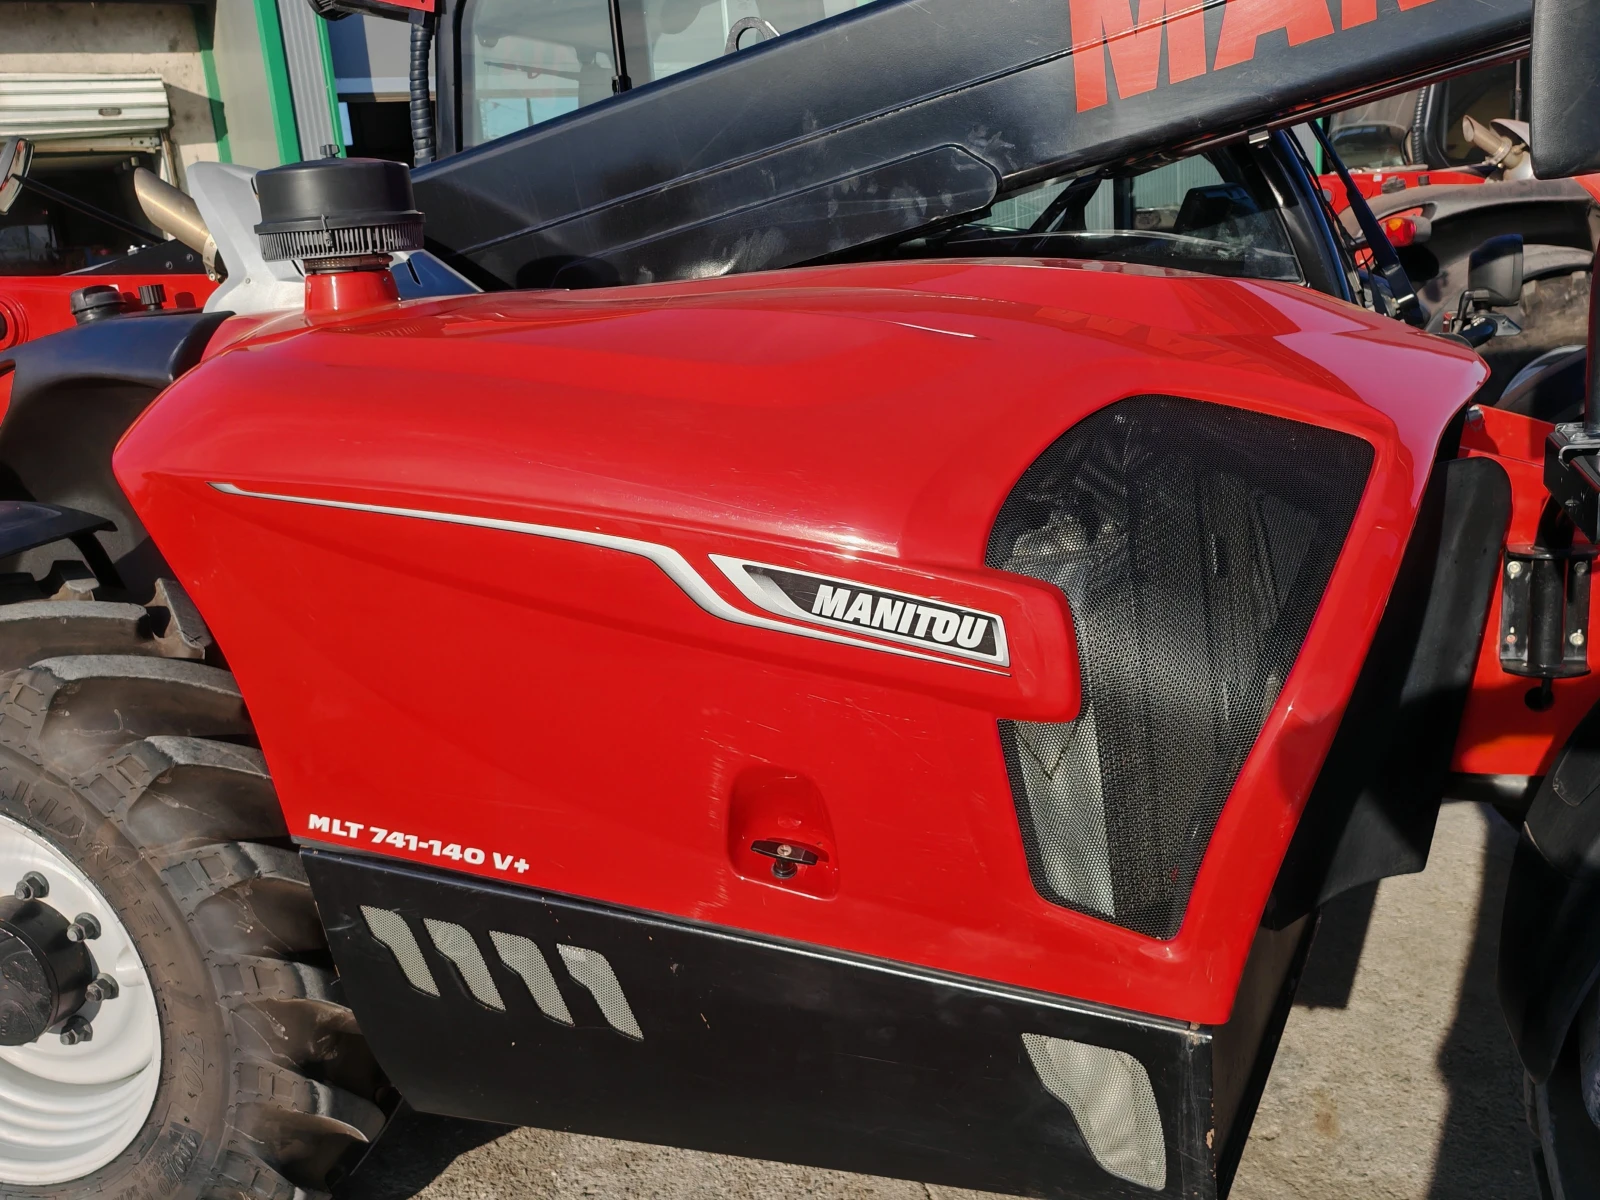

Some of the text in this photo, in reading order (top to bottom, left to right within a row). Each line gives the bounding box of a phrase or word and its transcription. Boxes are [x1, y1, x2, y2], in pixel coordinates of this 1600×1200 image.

[1069, 0, 1436, 113] MA
[811, 584, 989, 649] MANITOU
[308, 813, 530, 874] MLT 741-140 V+
